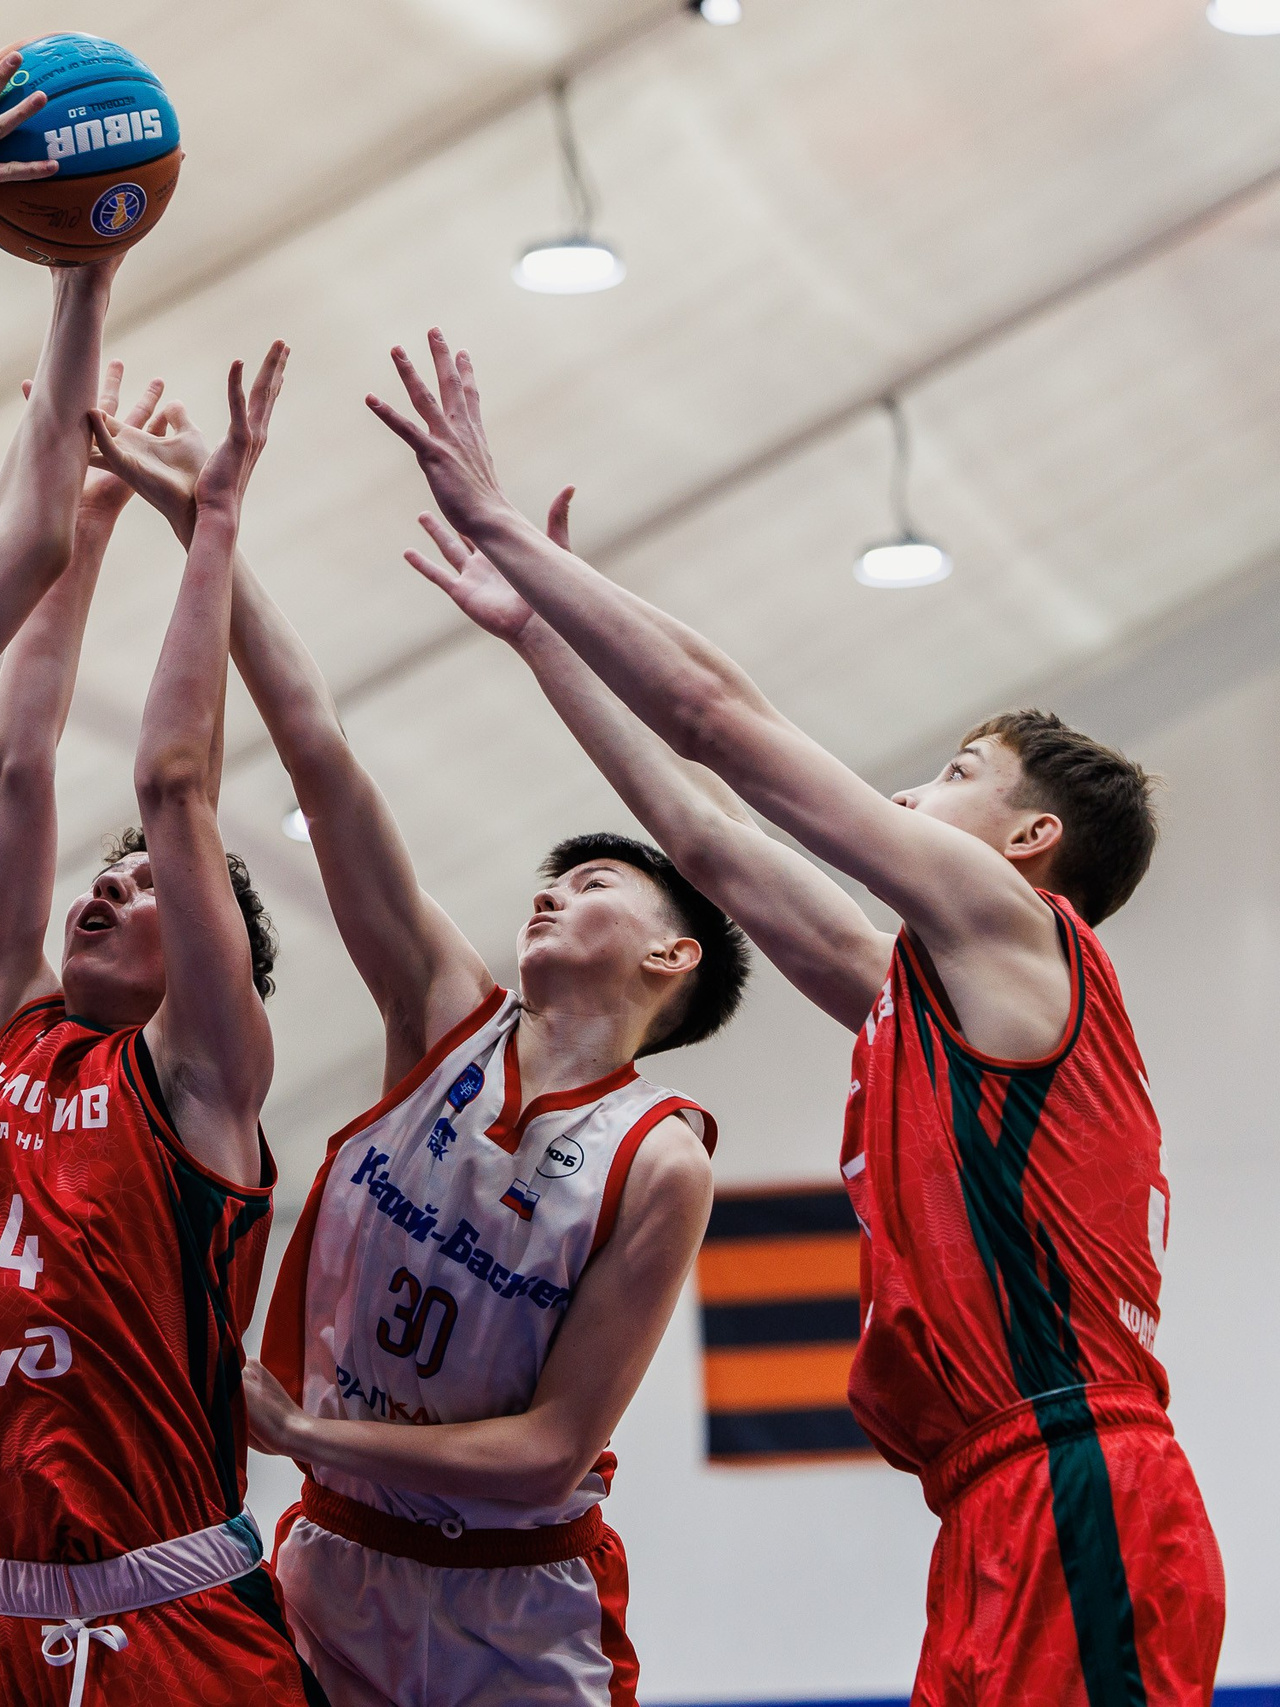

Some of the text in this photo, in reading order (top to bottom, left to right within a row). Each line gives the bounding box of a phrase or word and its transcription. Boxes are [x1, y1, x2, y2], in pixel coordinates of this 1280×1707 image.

[67, 106, 87, 118] 2.0
[44, 109, 163, 160] SIBUR
[545, 1146, 578, 1168] ФБ
[376, 1265, 459, 1379] 30
